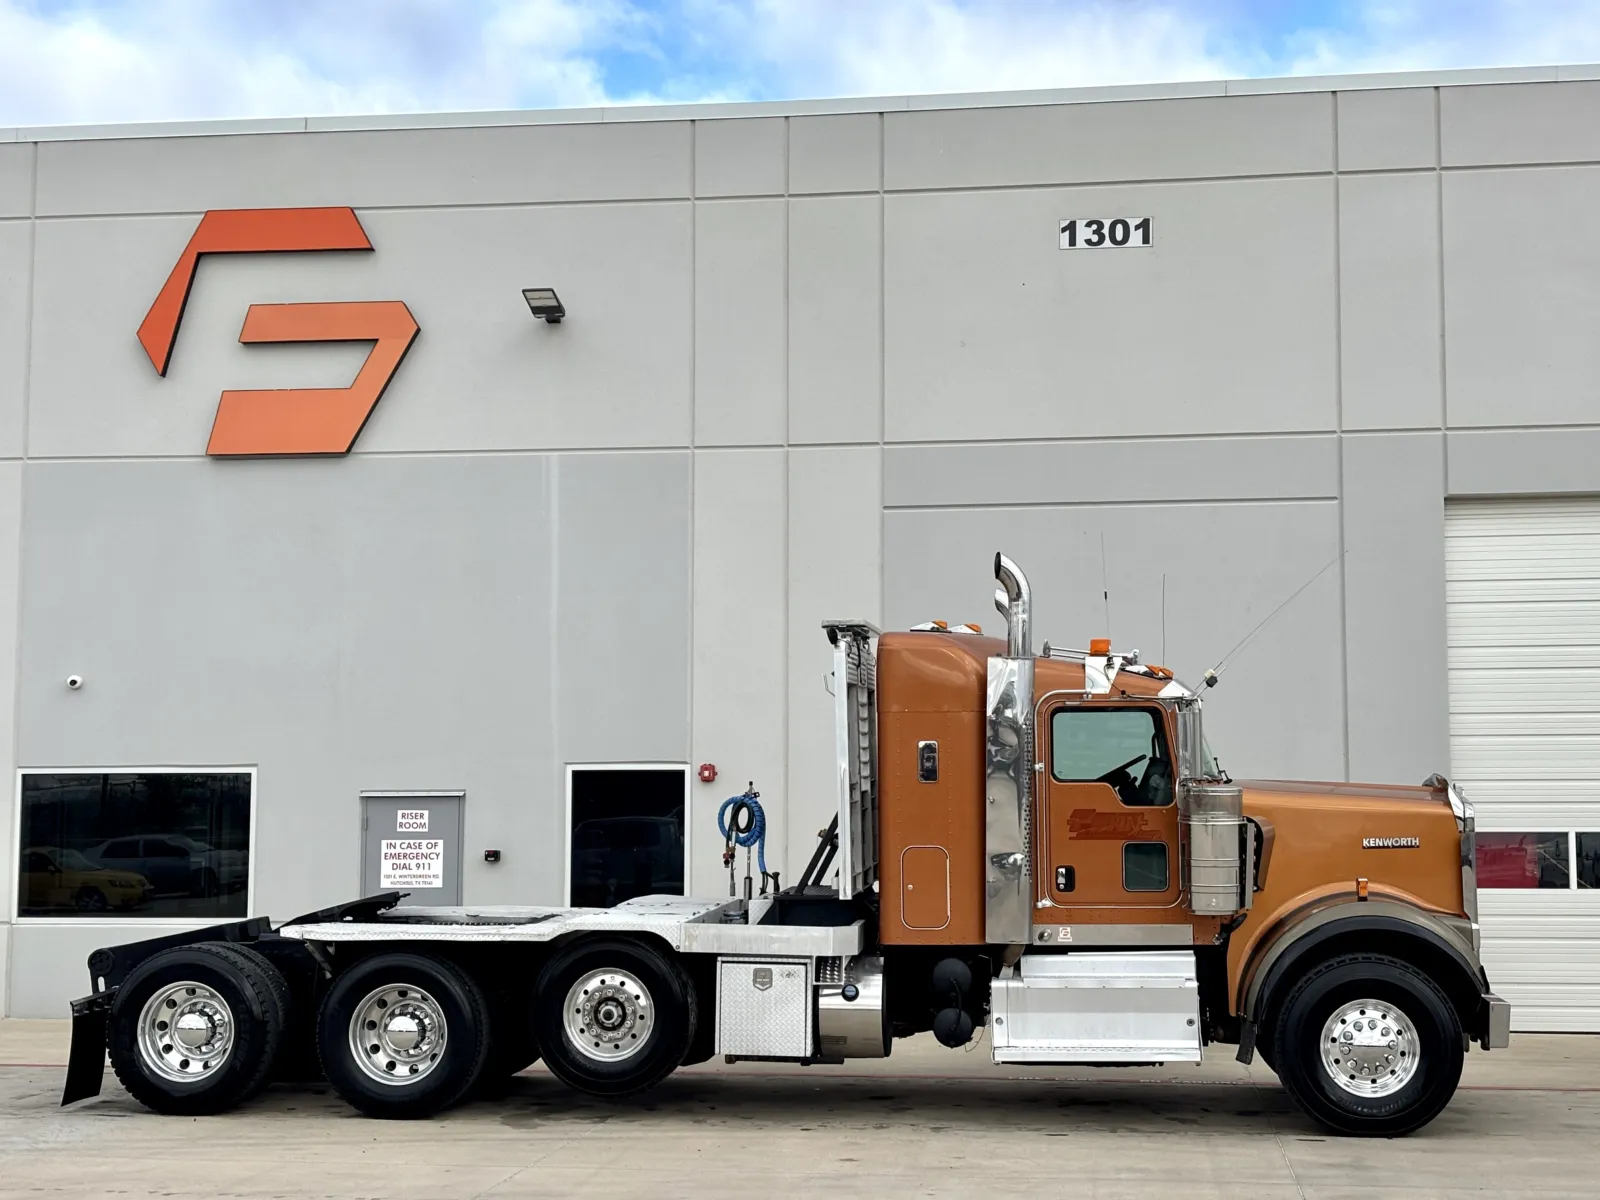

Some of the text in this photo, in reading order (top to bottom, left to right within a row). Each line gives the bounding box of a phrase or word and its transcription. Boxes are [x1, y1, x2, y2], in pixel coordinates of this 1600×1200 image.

[1061, 218, 1150, 247] 1301
[401, 812, 425, 820] RISER
[398, 821, 427, 829] ROOM
[386, 842, 439, 850] IN CASE OF
[1362, 837, 1419, 848] KENWORTH
[384, 852, 441, 860] EMERGENCY
[391, 862, 431, 871] DIAL 911
